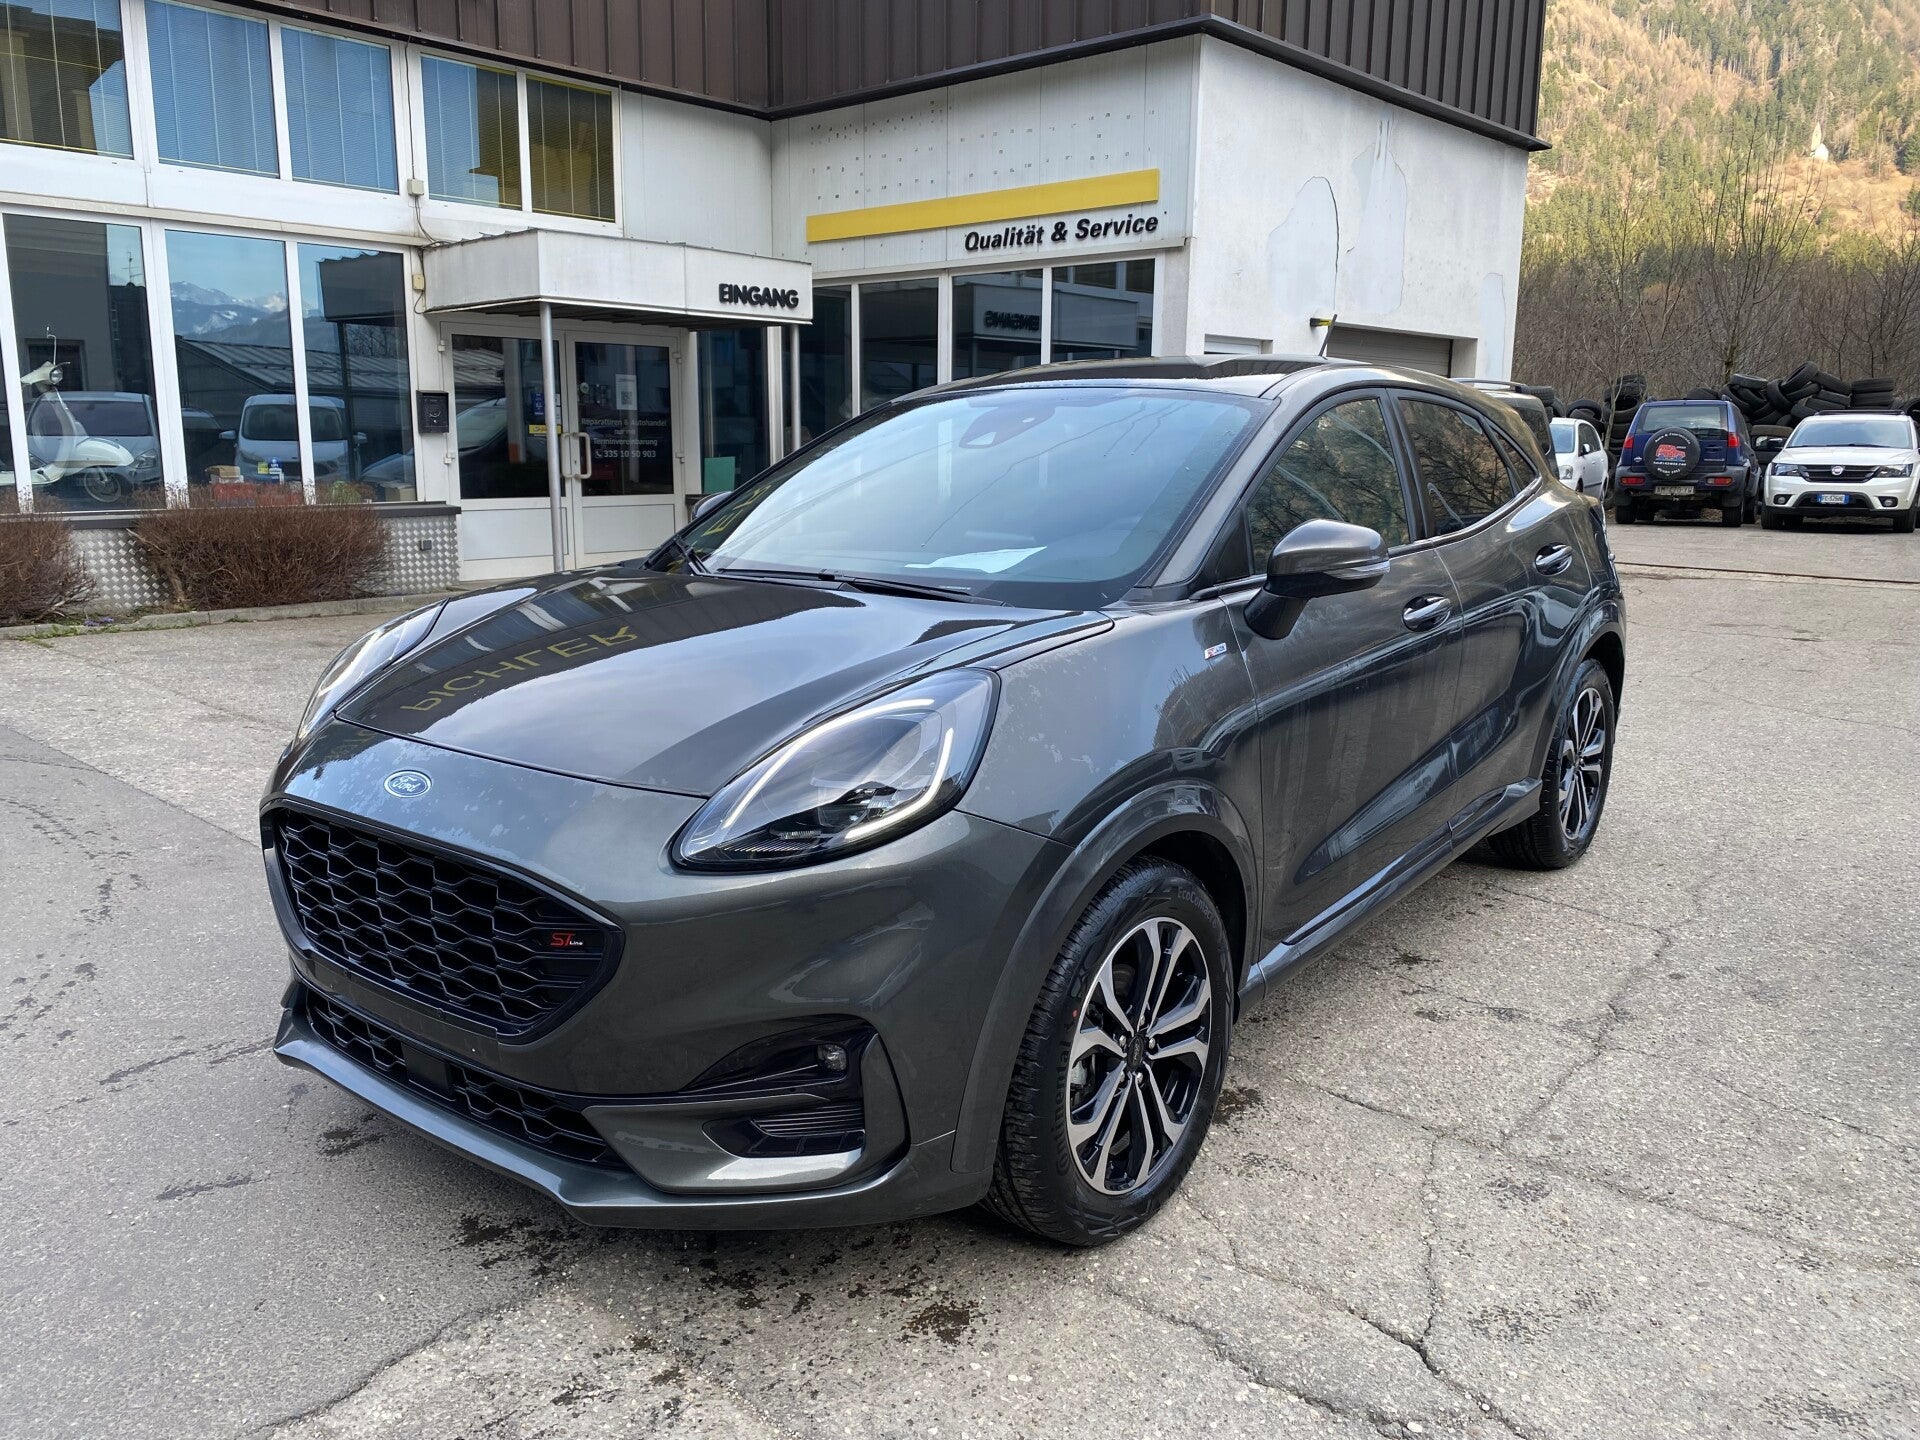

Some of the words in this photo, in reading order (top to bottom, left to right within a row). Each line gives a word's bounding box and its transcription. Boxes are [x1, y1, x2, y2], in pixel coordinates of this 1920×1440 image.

[965, 225, 1044, 251] Qualität
[1051, 221, 1068, 242] &
[1075, 214, 1159, 239] Service
[719, 284, 799, 309] EINGANG
[581, 418, 622, 427] Reparaturen
[630, 419, 667, 427] Autohandel
[594, 438, 658, 447] Terminvereinbarung
[604, 450, 618, 458] 335
[620, 450, 629, 458] 10
[631, 450, 641, 458] 50
[643, 450, 657, 458] 903
